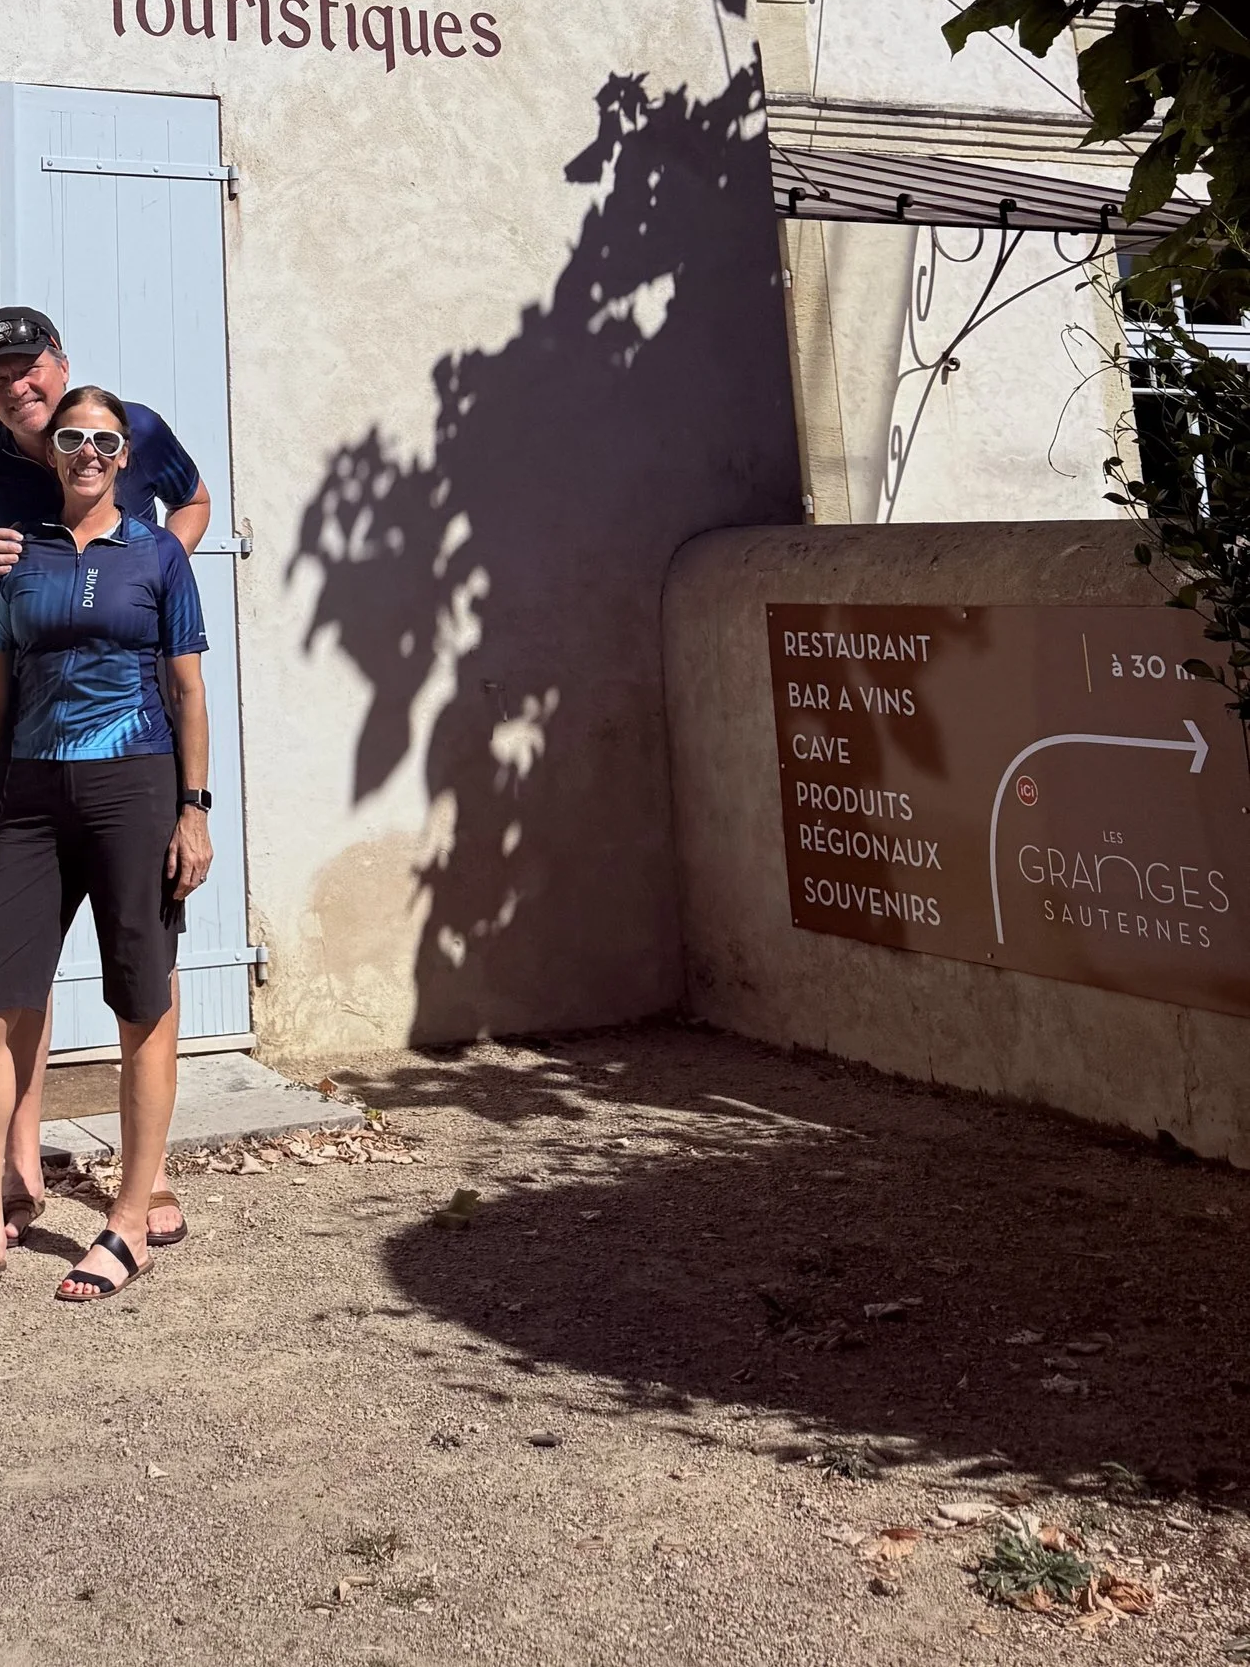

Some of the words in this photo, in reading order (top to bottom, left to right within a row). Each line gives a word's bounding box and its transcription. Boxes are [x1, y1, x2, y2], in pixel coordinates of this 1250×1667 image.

[82, 568, 98, 607] DUVINE
[784, 631, 930, 662] RESTAURANT
[1111, 653, 1123, 677] à
[1131, 655, 1166, 679] 30
[788, 682, 830, 710] BAR
[838, 686, 853, 712] A
[859, 686, 915, 716] VINS
[792, 734, 850, 764] CAVE
[796, 781, 913, 821] PRODUITS
[800, 819, 942, 870] RÉGIONAUX
[1103, 831, 1124, 844] LES
[804, 876, 941, 926] SOUVENIRS
[1044, 900, 1211, 948] SAUTERNES
